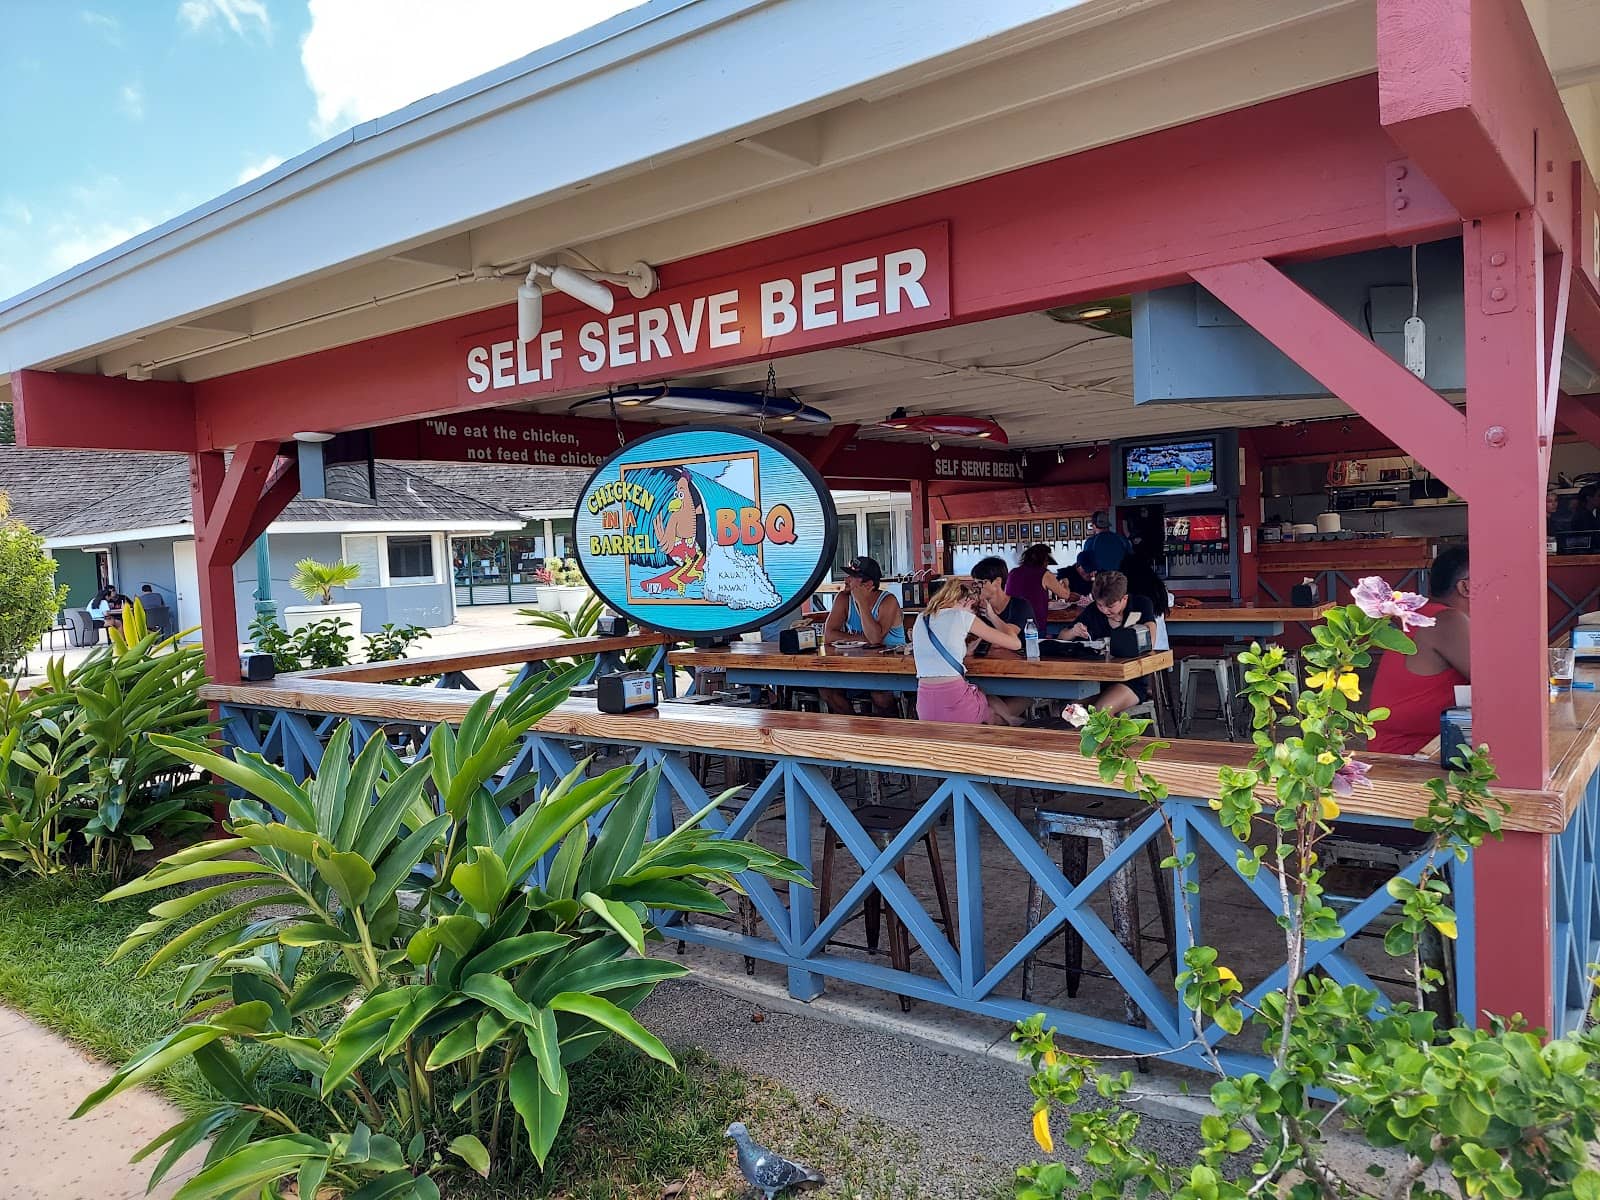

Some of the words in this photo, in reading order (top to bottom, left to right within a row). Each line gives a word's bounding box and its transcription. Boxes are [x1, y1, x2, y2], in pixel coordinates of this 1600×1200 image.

[467, 329, 564, 394] SELF
[578, 289, 741, 373] SERVE
[759, 248, 931, 339] BEER
[426, 420, 457, 436] "We
[463, 425, 489, 438] eat
[493, 426, 517, 440] the
[522, 428, 580, 447] chicken,
[467, 447, 492, 459] not
[497, 447, 528, 461] feed
[534, 449, 556, 462] the
[935, 458, 959, 475] SELF
[961, 460, 991, 477] SERVE
[992, 462, 1015, 478] BEER
[587, 480, 655, 515] CHICKEN
[624, 510, 637, 528] A
[716, 503, 798, 546] BBQ
[590, 534, 656, 556] BARREL
